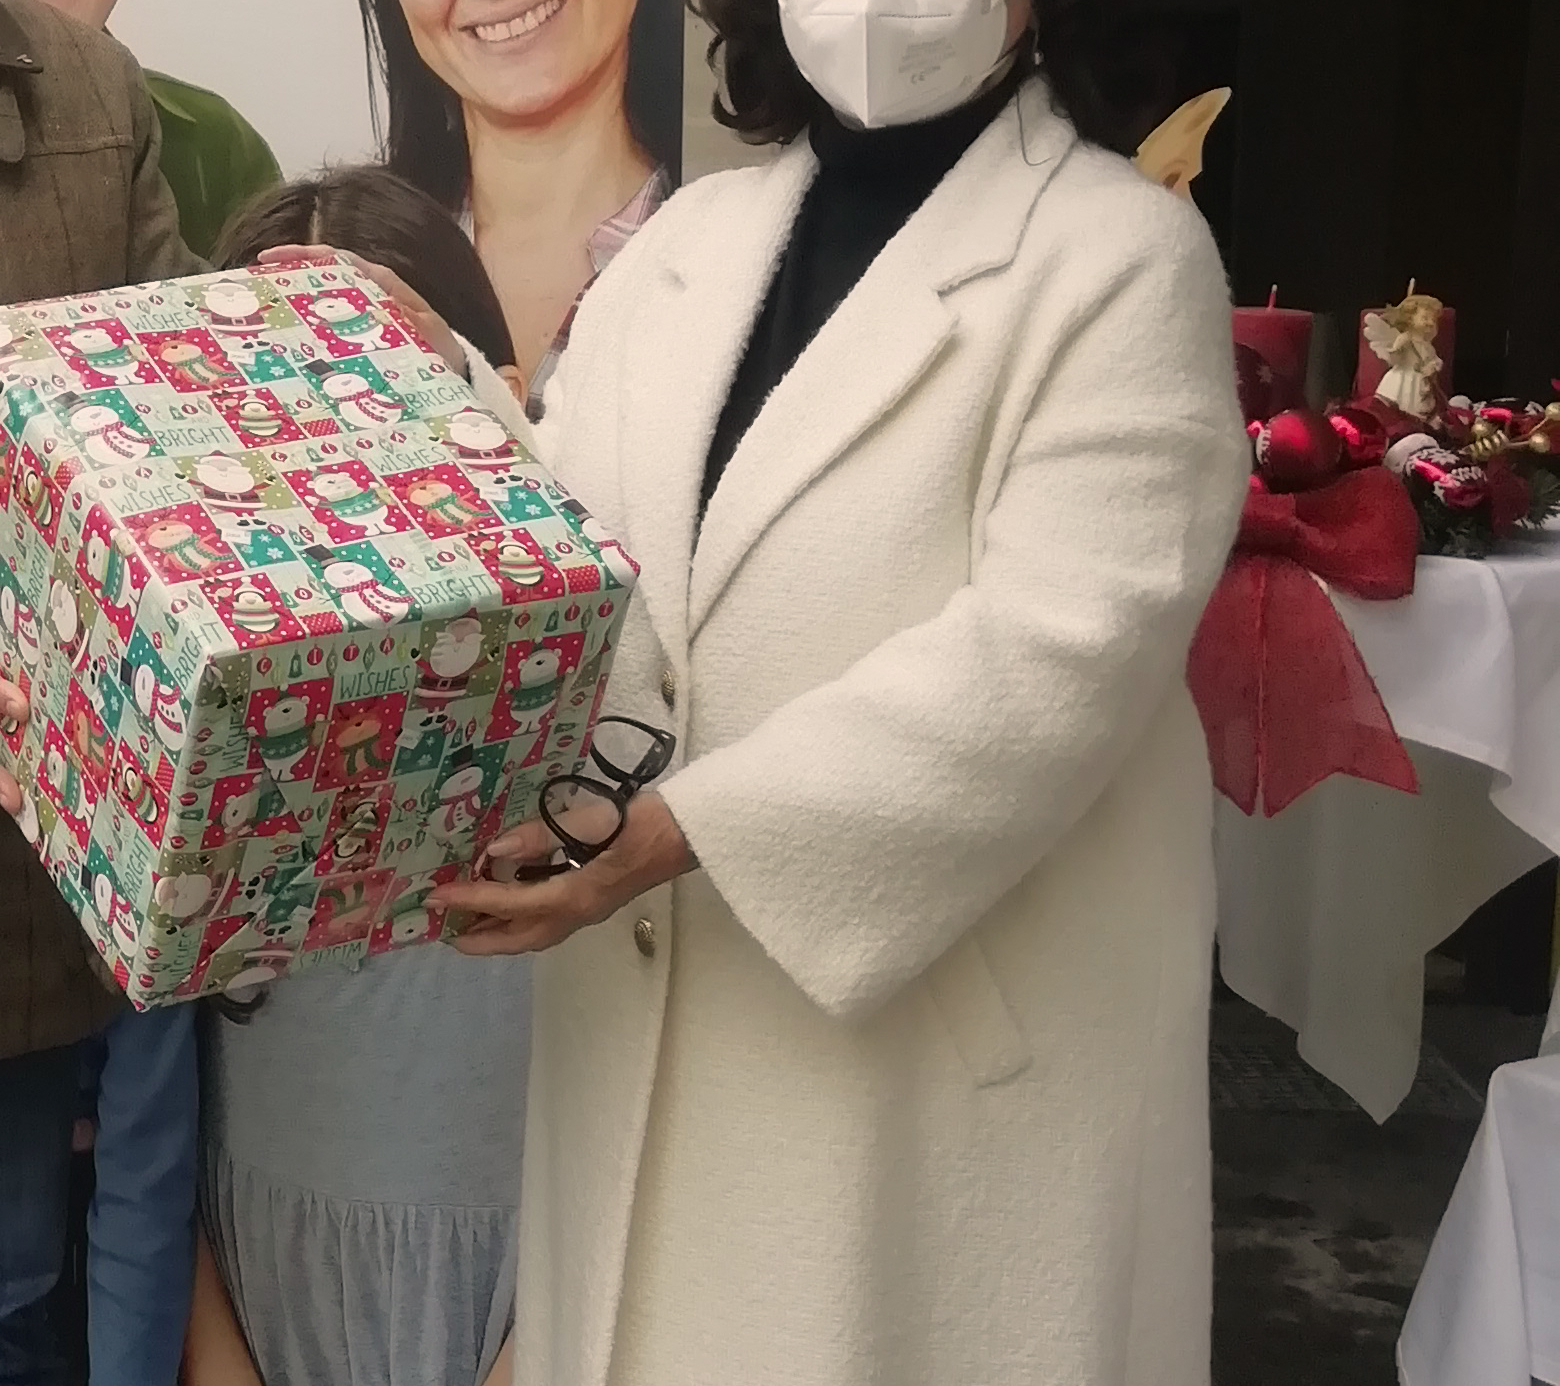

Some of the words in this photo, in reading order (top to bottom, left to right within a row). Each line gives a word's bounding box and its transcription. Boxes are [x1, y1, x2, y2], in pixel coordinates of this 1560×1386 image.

[130, 311, 200, 331] WISHES
[404, 382, 481, 411] BRIGHT
[154, 425, 234, 448] BRIGHT
[369, 446, 447, 473] WISHES
[110, 483, 191, 514] WISHES
[26, 535, 49, 611] BRIGHT
[410, 574, 494, 606] BRIGHT
[173, 621, 224, 692] BRIGHT
[340, 665, 411, 700] WISHES
[123, 828, 153, 904] BRIGHT
